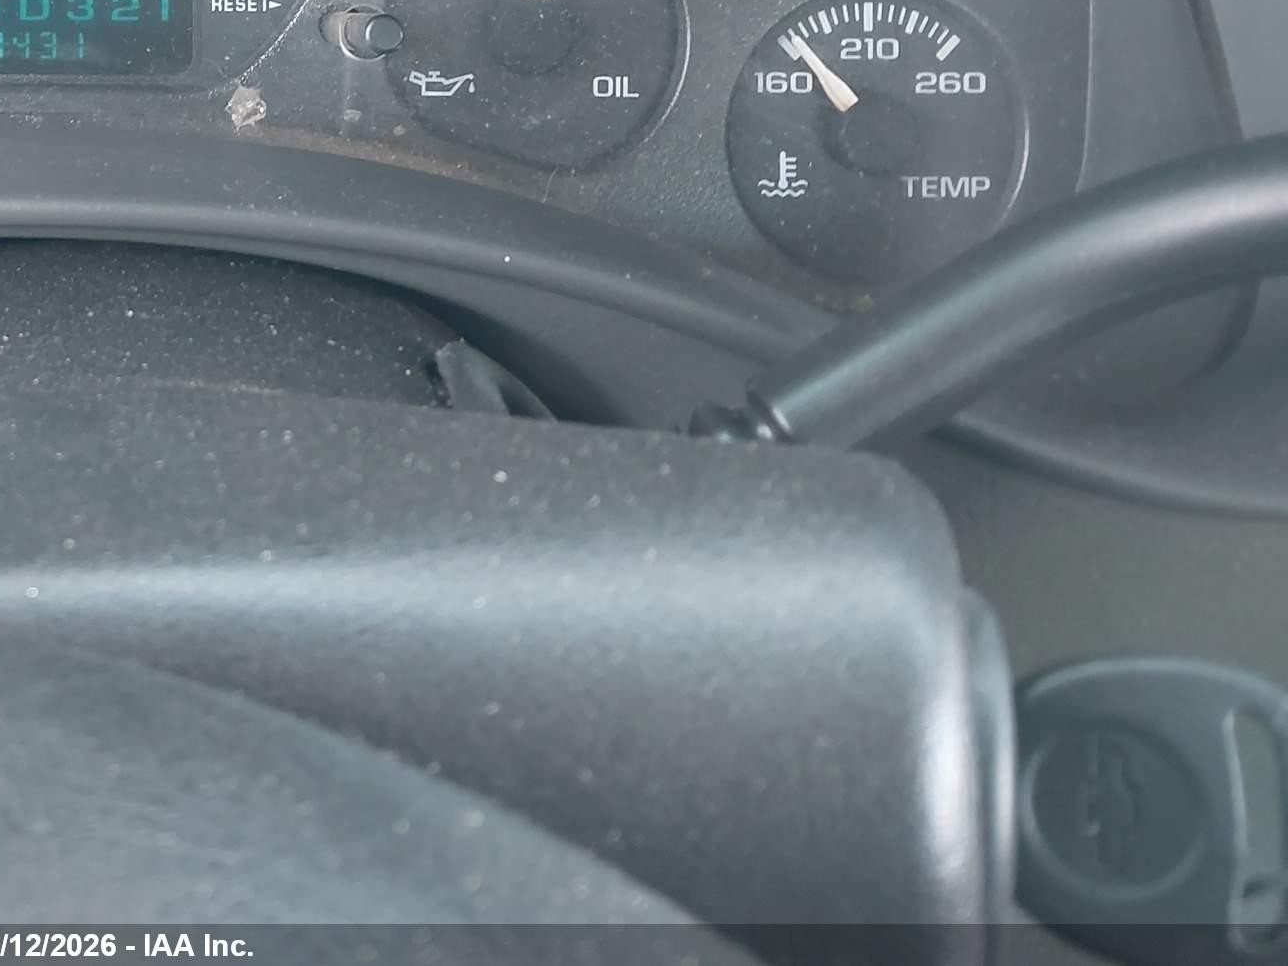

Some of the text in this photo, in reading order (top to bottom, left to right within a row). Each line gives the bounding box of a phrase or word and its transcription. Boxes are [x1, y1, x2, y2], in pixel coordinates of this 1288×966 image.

[839, 38, 899, 60] 210
[593, 77, 639, 97] OIL
[754, 72, 812, 93] 160
[915, 72, 986, 94] 260
[902, 176, 991, 197] TEMP
